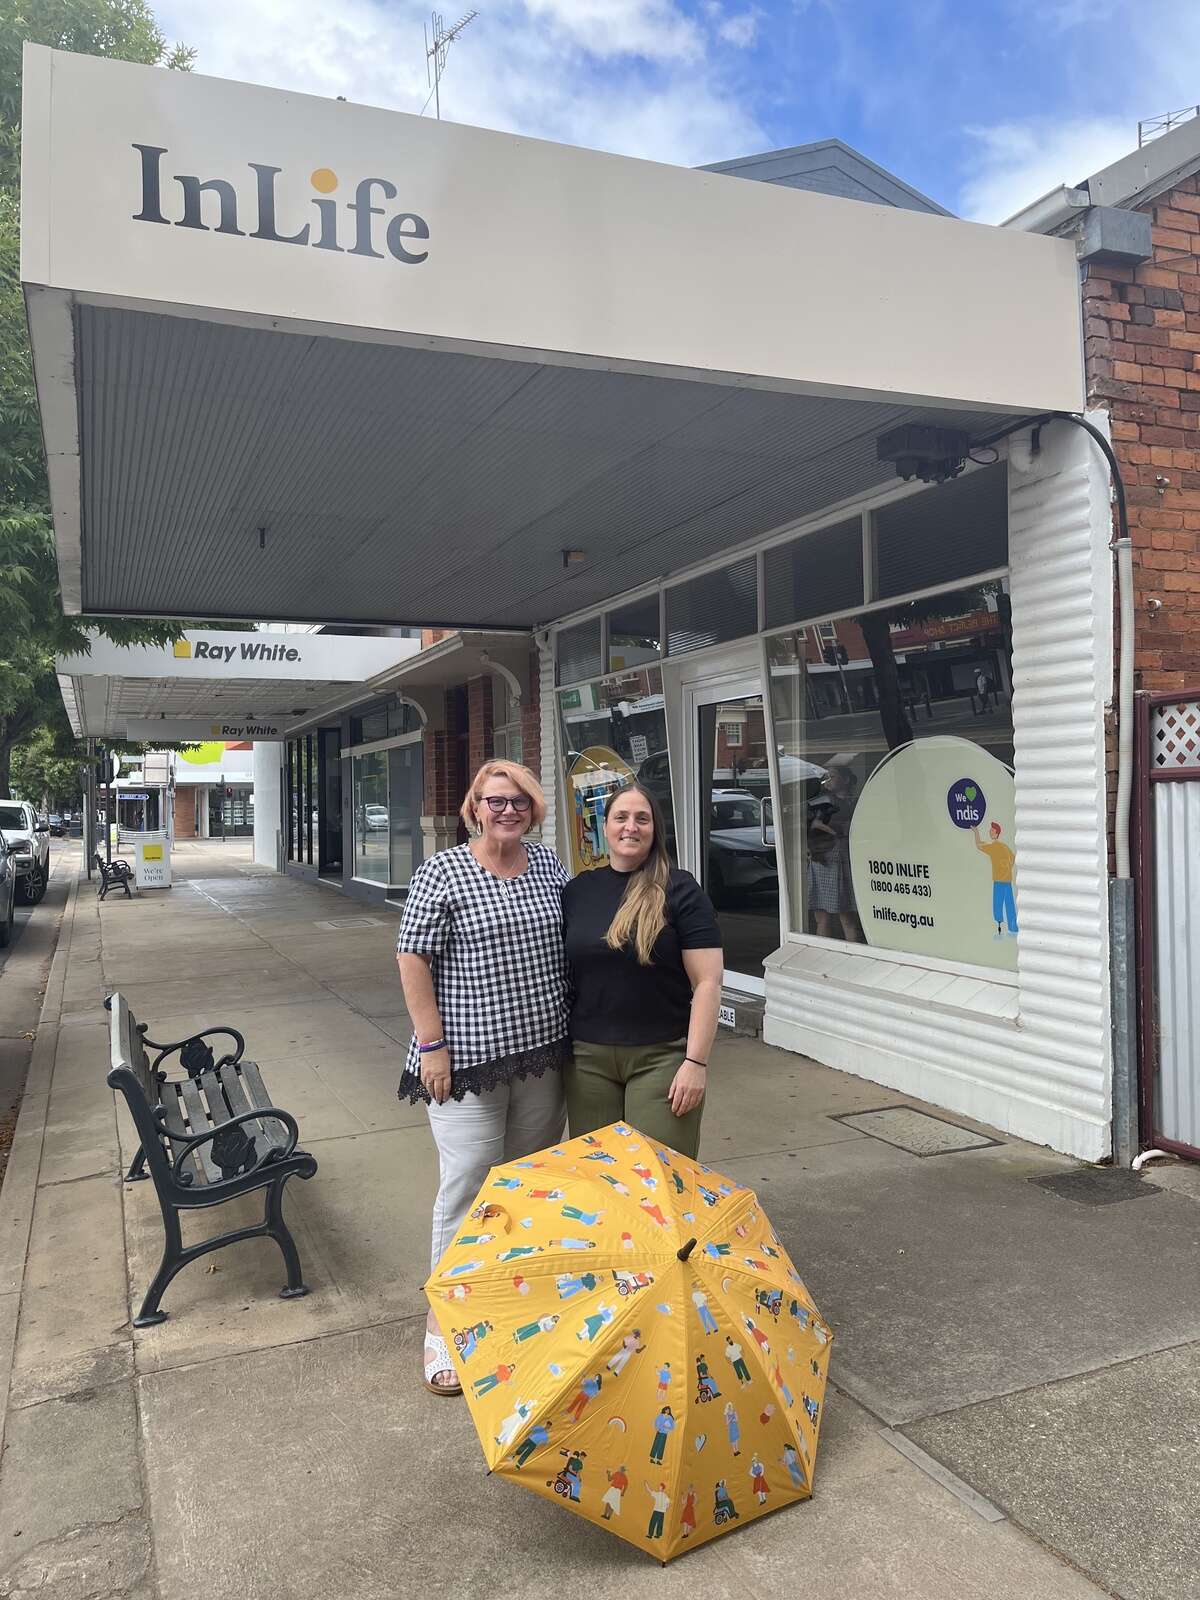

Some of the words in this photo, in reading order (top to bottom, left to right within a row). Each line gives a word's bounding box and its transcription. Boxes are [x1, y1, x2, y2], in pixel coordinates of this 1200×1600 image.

[131, 143, 430, 264] InLife
[194, 641, 236, 662] Ray
[240, 643, 302, 662] White.
[222, 725, 244, 737] Ray
[246, 725, 278, 736] White
[955, 793, 967, 802] We
[956, 804, 979, 821] ndis
[144, 874, 163, 883] Open
[868, 860, 894, 876] 1800
[895, 863, 930, 879] INLIFE
[870, 879, 893, 893] (1800
[894, 883, 911, 895] 465
[912, 884, 932, 898] 433)
[872, 905, 935, 929] inlife.org.au
